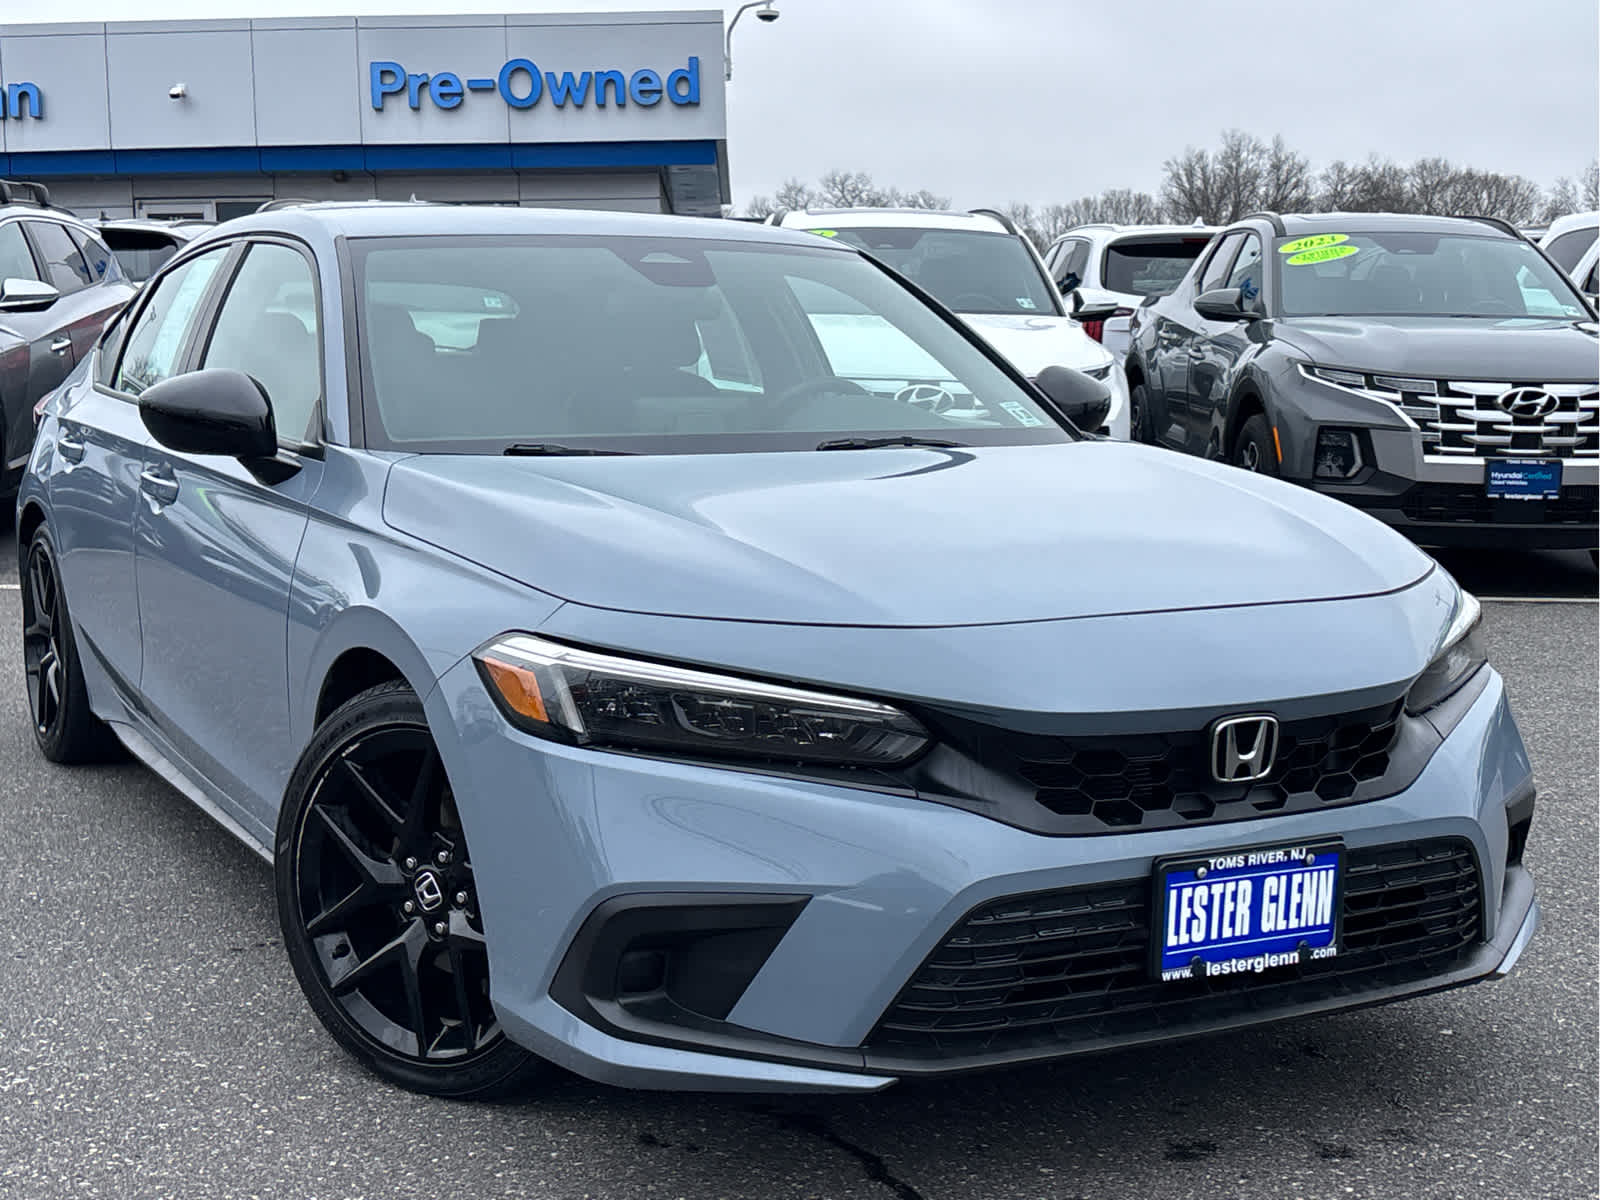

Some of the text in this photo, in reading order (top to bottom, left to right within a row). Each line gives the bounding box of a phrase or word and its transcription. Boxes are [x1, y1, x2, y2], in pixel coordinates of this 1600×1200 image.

[370, 56, 701, 111] Pre-Owned
[0, 82, 44, 120] n
[1491, 471, 1522, 480] Hyundai
[1208, 848, 1306, 872] TOMS RIVER, NJ
[1167, 869, 1335, 947] LESTER GLENN
[1206, 952, 1299, 976] lesterglenn
